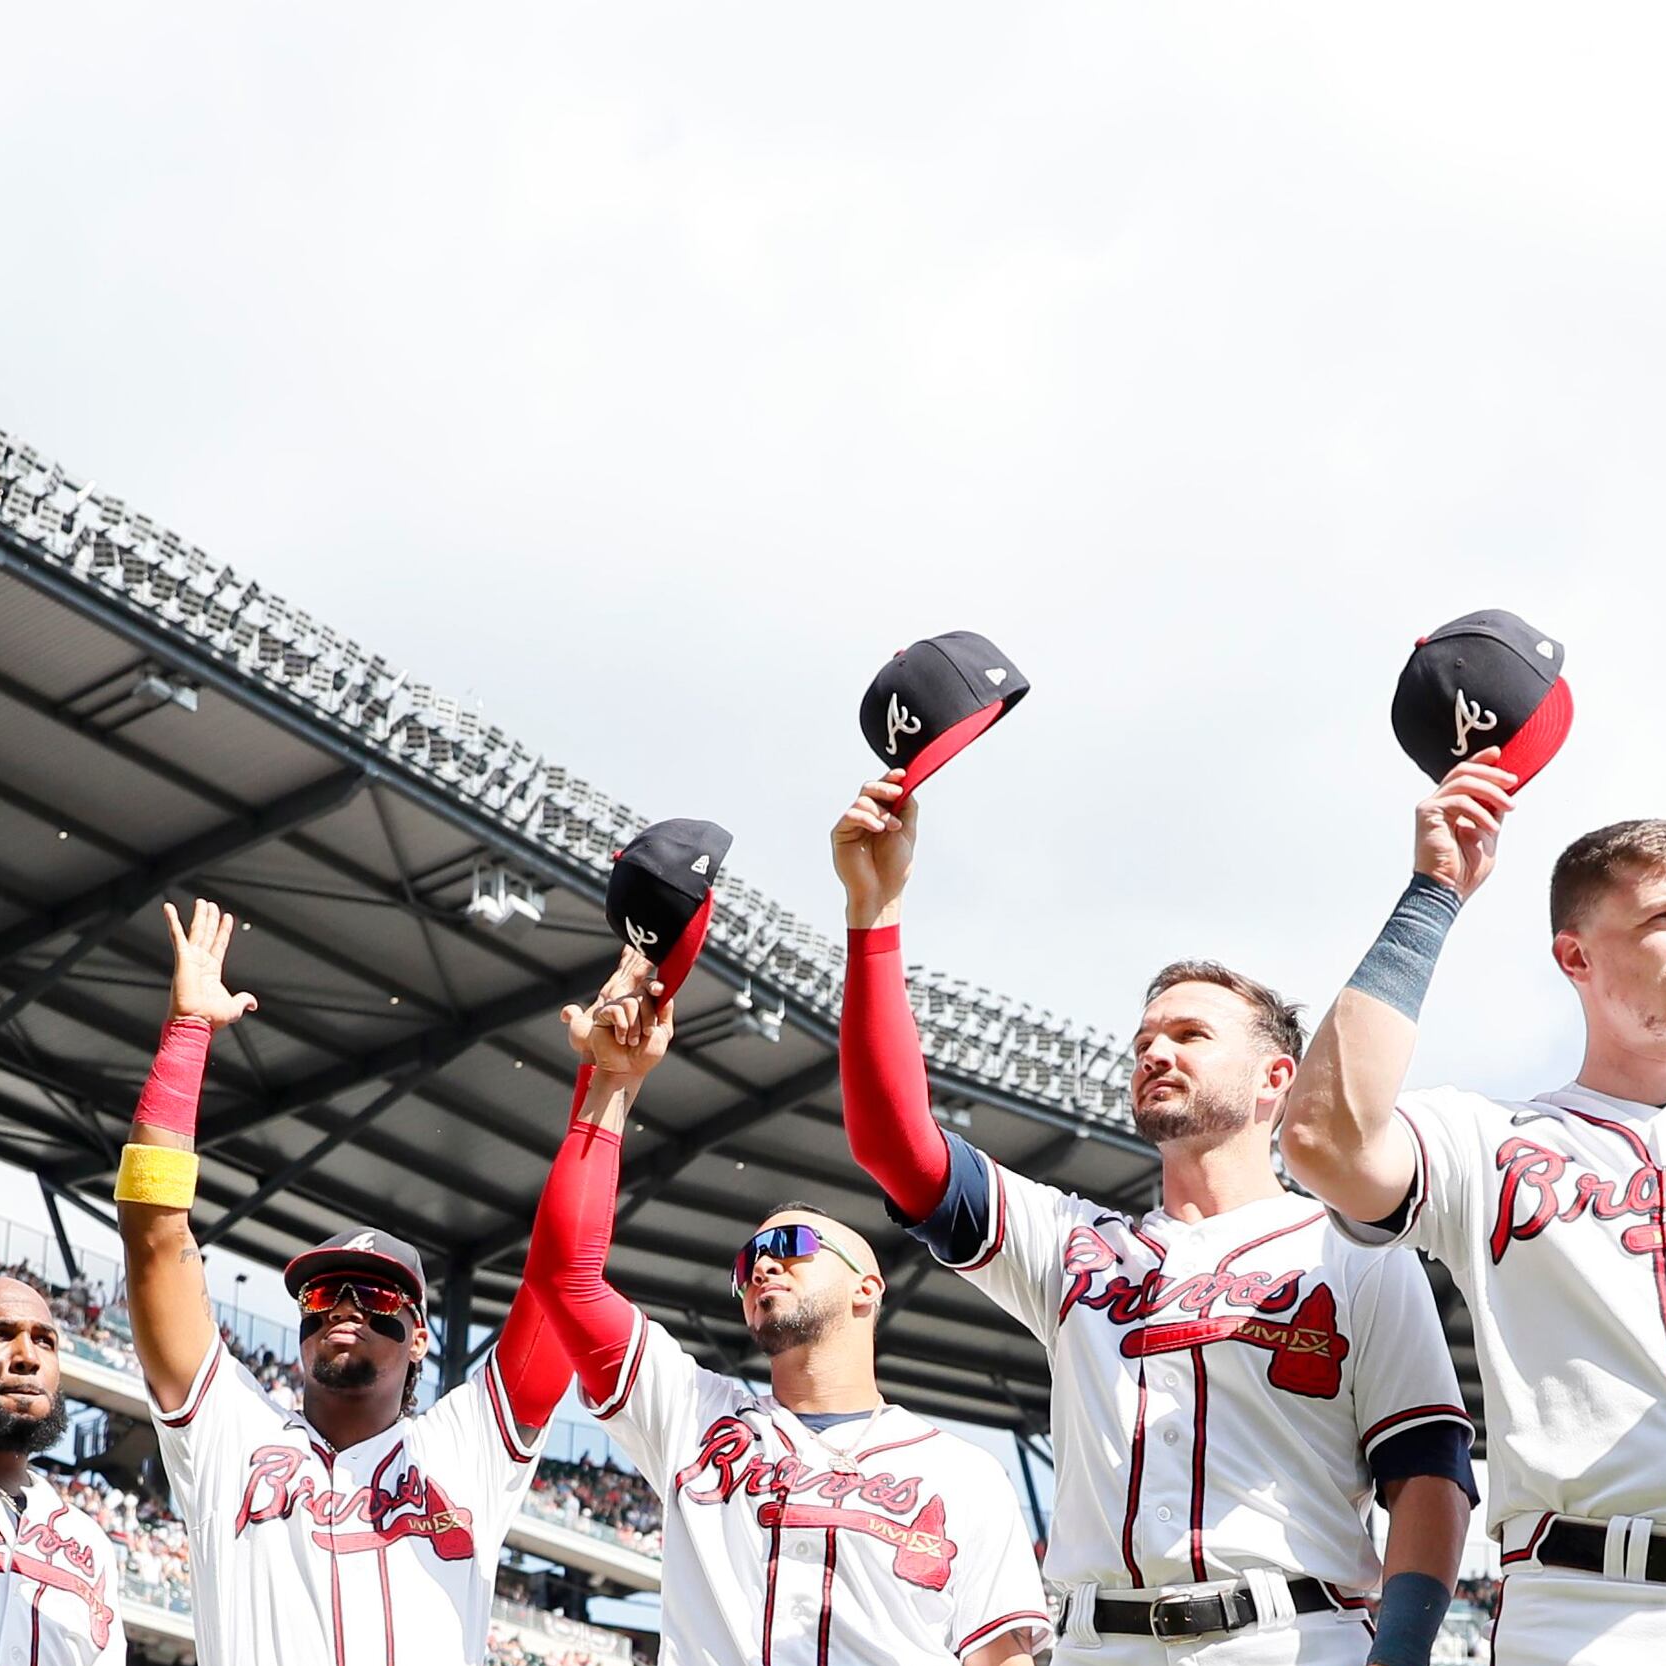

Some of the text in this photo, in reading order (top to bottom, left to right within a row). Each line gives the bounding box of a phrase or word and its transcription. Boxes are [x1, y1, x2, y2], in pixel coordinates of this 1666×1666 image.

[885, 692, 922, 756] A
[1450, 688, 1498, 757] A
[1058, 1225, 1307, 1327] Braves
[234, 1444, 423, 1540] Braves
[674, 1414, 924, 1515] Braves
